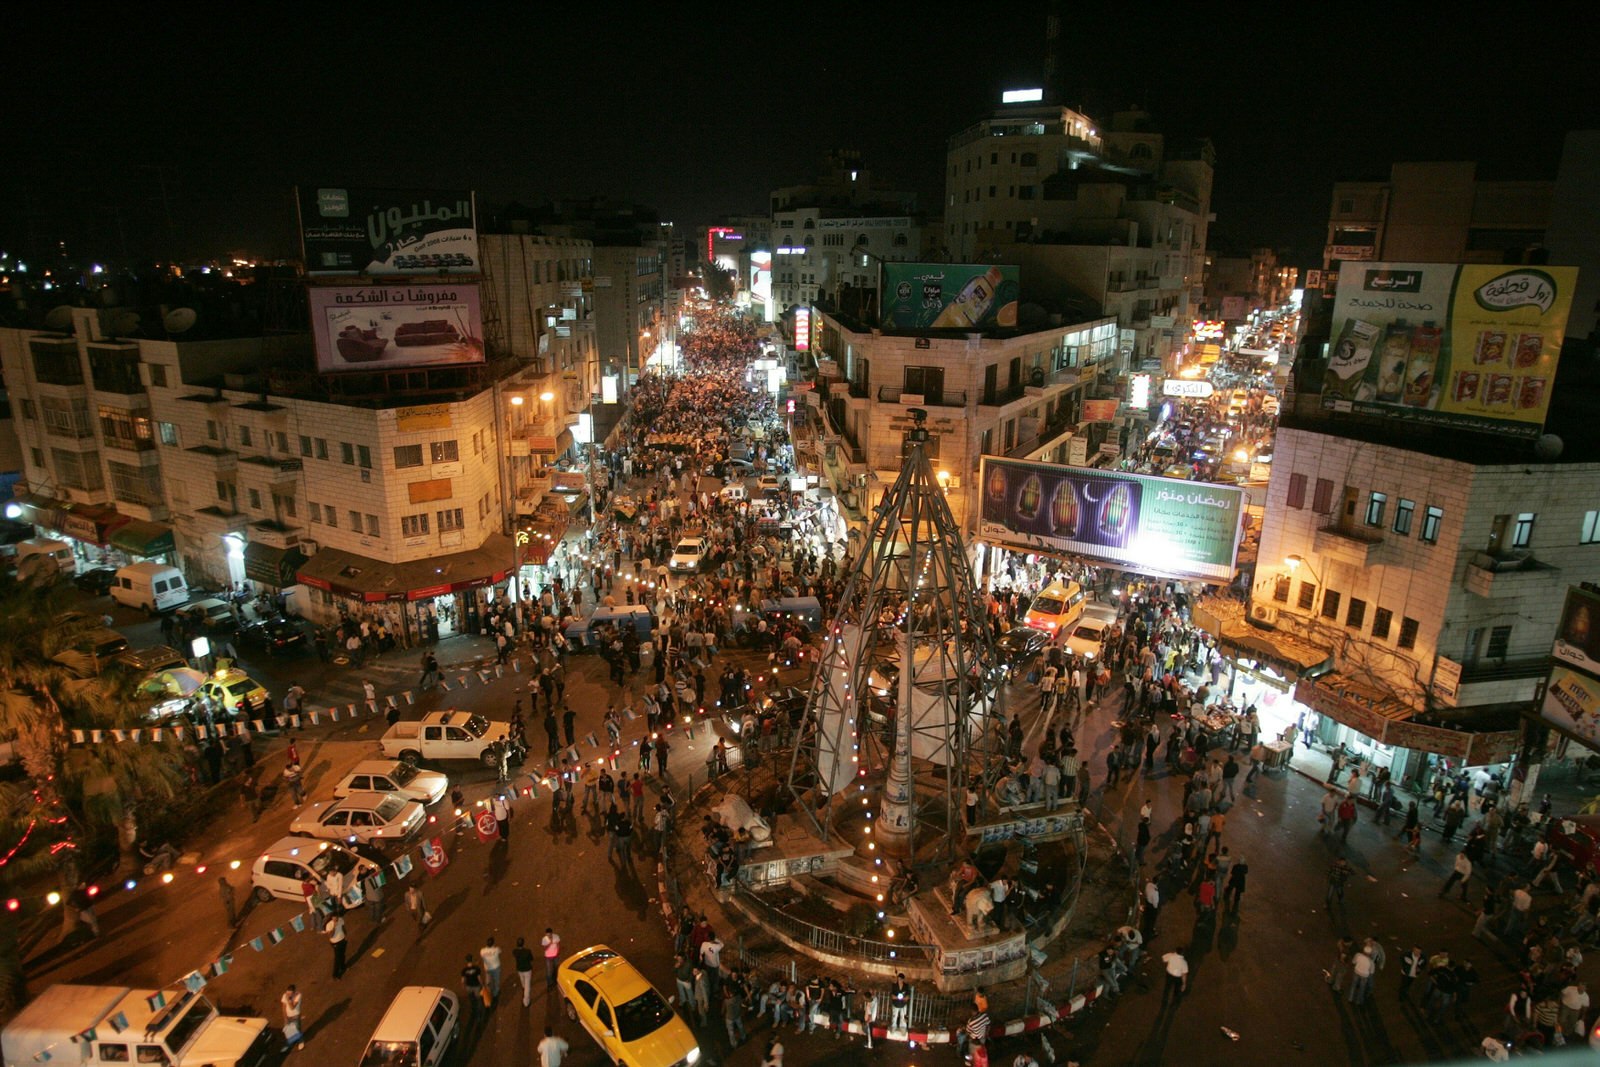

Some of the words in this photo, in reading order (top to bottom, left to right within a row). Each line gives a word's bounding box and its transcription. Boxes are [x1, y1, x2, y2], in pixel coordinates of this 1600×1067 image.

[366, 199, 470, 250] المليون
[1371, 273, 1415, 288] الربيع
[1187, 493, 1231, 509] رمضان
